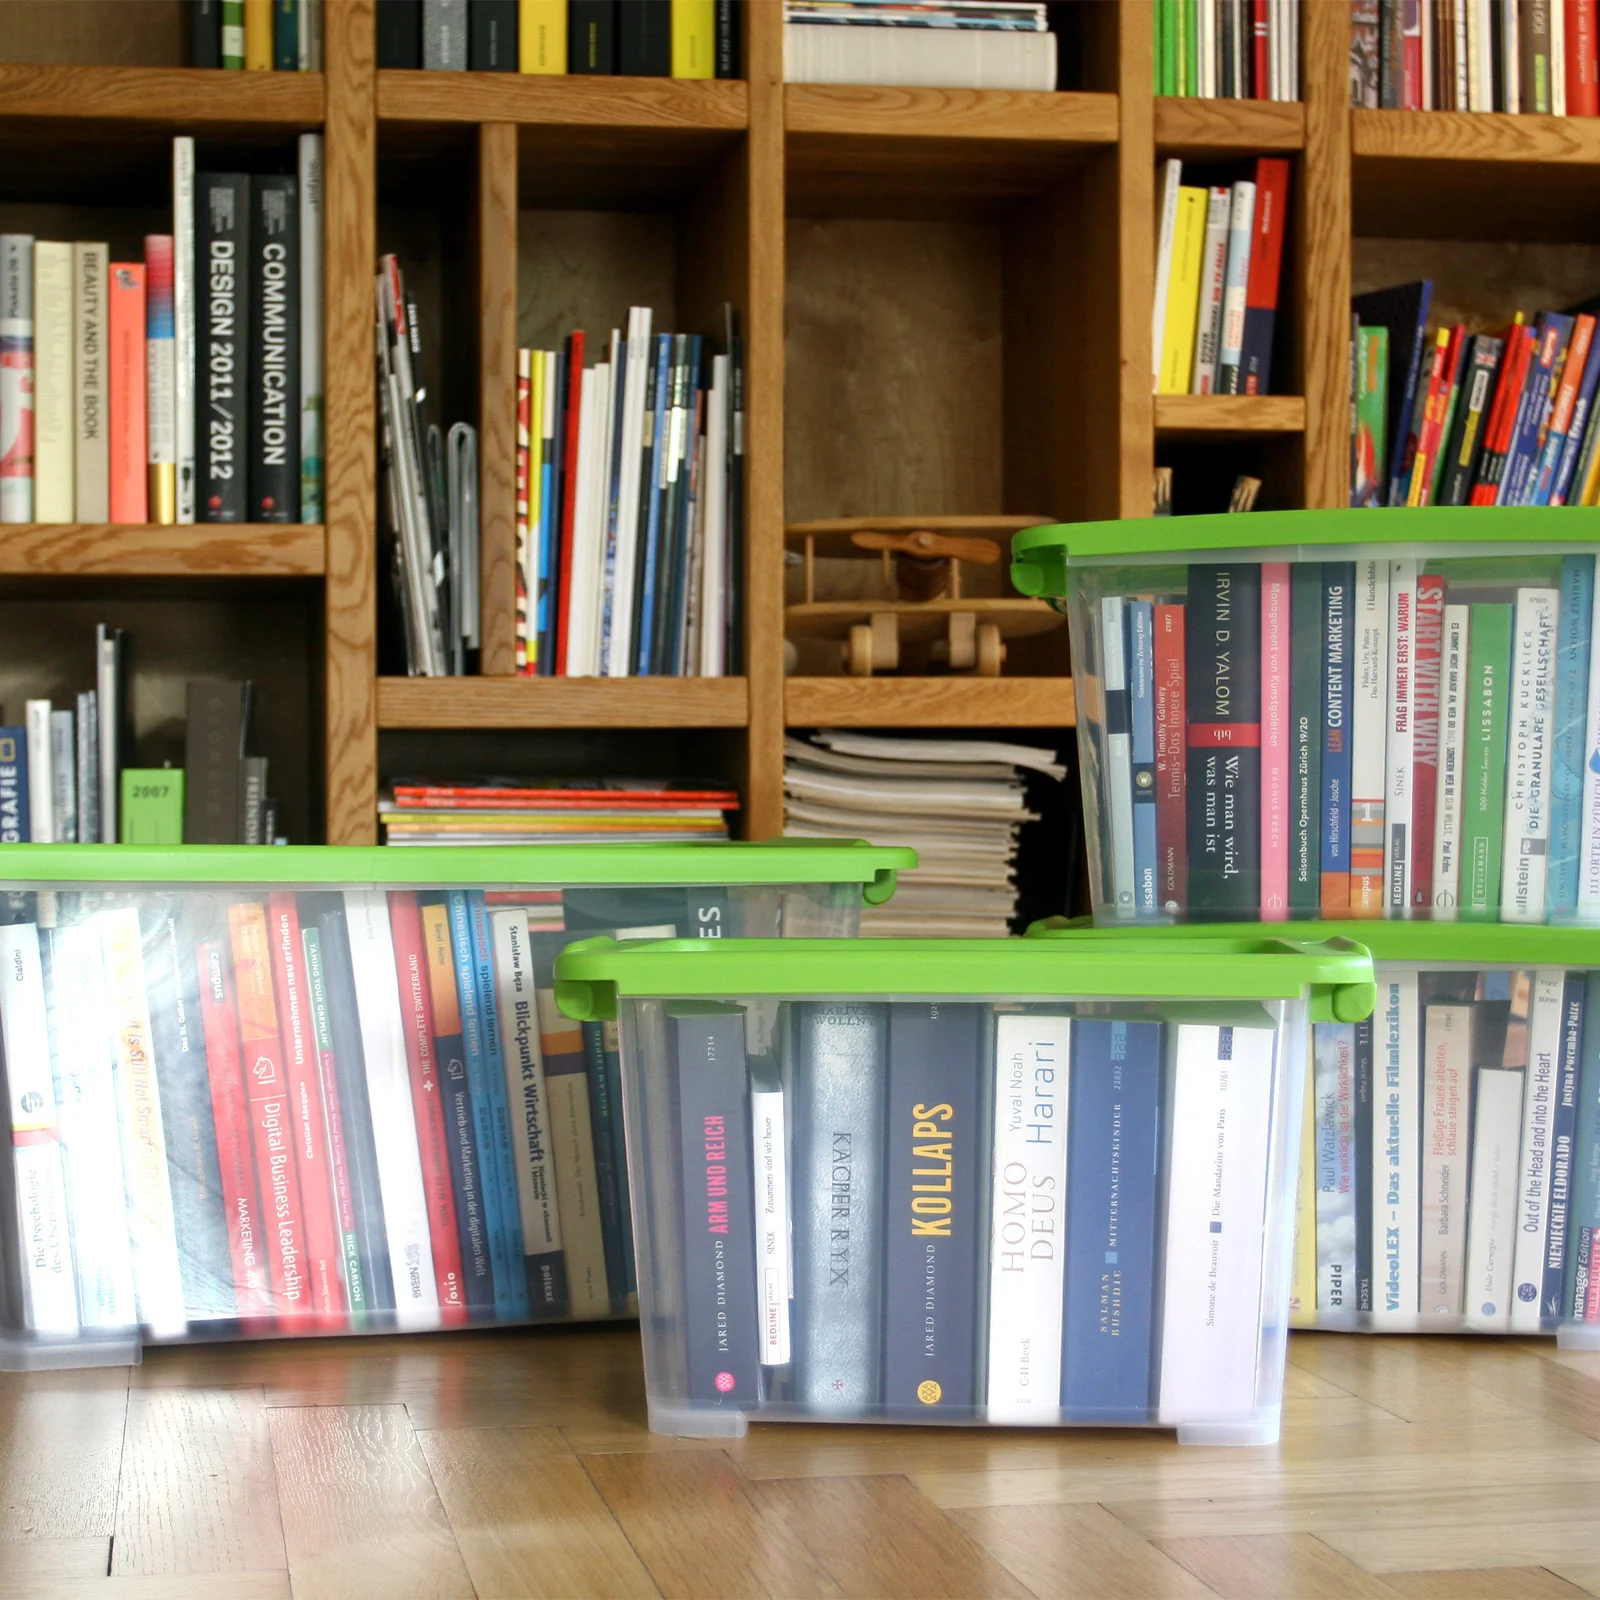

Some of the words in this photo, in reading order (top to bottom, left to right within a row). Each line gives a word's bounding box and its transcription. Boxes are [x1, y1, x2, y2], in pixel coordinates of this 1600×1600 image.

[84, 252, 100, 317] BEAUTY
[211, 240, 234, 336] DESIGN
[85, 320, 100, 355] AND
[263, 243, 286, 465] COMMUNICATION
[85, 359, 101, 389] THE
[85, 395, 101, 440] BOOK
[209, 342, 234, 480] 2011/2012
[1216, 572, 1230, 621] IRVIN
[1397, 593, 1409, 632] WARUM
[1268, 583, 1280, 651] Management
[1328, 586, 1342, 663] MARKETING
[1416, 587, 1442, 654] START
[1451, 622, 1459, 630] ES
[1216, 630, 1230, 647] D.
[1396, 635, 1408, 663] ERST:
[1450, 631, 1459, 651] KOMMT
[1449, 653, 1458, 669] NICHT
[1520, 630, 1532, 708] KUCKLICK
[1216, 652, 1230, 716] YALOM
[1328, 666, 1342, 727] CONTENT
[1396, 666, 1408, 703] IMMER
[1415, 658, 1440, 713] WITH
[1447, 694, 1456, 704] AN,
[1448, 671, 1457, 693] DARAUF
[1157, 686, 1167, 721] Gallwey
[1268, 675, 1280, 747] Kunstgalerien
[1396, 705, 1408, 733] FRAG
[1448, 706, 1456, 719] WER
[1481, 664, 1493, 741] LISSABON
[1157, 723, 1167, 758] Timothy
[1298, 717, 1309, 743] 19/20
[1328, 729, 1342, 753] LEAN
[1414, 718, 1439, 768] WHY
[1447, 720, 1456, 729] DU
[1157, 760, 1166, 771] W.
[1206, 756, 1216, 786] was
[1224, 755, 1238, 788] Wie
[1298, 745, 1308, 774] Zürich
[1446, 747, 1455, 772] SONDERN
[1515, 719, 1528, 810] CHRISTOPH
[132, 786, 171, 798] 2007
[1394, 767, 1404, 797] SINEK
[1445, 773, 1454, 786] WER
[1445, 788, 1453, 796] DU
[0, 766, 20, 842] GRAFIE
[1206, 792, 1216, 827] man
[1224, 794, 1234, 830] man
[1298, 777, 1309, 827] Opernhaus
[1206, 833, 1219, 853] ist
[1220, 837, 1238, 880] wird,
[1298, 830, 1307, 882] Saisonbuch
[1443, 841, 1451, 854] Paul
[1442, 855, 1451, 874] Arden.
[1393, 864, 1403, 905] REDLINE
[280, 914, 293, 962] erfinden
[454, 895, 470, 962] Chinesisch
[473, 895, 489, 962] Chinesisch
[698, 906, 722, 938] ES
[13, 949, 24, 982] Cialdini
[510, 926, 521, 968] Stanisław
[210, 952, 225, 999] campus
[286, 964, 295, 985] neu
[409, 953, 425, 1011] SWITZERLAND
[461, 965, 476, 1016] spielend
[480, 965, 495, 1016] spielend
[513, 971, 523, 992] Bęza
[289, 987, 304, 1065] Unternehmen
[415, 1014, 429, 1057] COMPLETE
[468, 1018, 479, 1056] lernen
[487, 1018, 497, 1056] lernen
[515, 1001, 537, 1081] Blickpunkt
[1386, 983, 1399, 1087] Filmlexikon
[420, 1059, 431, 1075] THE
[1009, 1052, 1023, 1089] Noah
[1337, 1040, 1348, 1101] Wirklichkeit?
[1434, 1042, 1449, 1084] arbeiten,
[1447, 1068, 1459, 1084] auf
[1533, 1052, 1550, 1083] Heart
[1026, 1041, 1055, 1144] Harari
[1338, 1103, 1348, 1118] die
[1433, 1085, 1446, 1117] Frauen
[1447, 1086, 1461, 1120] steigen
[1532, 1085, 1548, 1103] the
[262, 1103, 286, 1152] Digital
[523, 1083, 545, 1162] Wirtschaft
[763, 1117, 772, 1140] besser
[1008, 1094, 1023, 1132] Yuval
[1215, 1108, 1226, 1130] Paris
[1321, 1093, 1334, 1163] Watzlawick
[1338, 1120, 1348, 1133] ist
[1386, 1093, 1399, 1167] aktuelle
[1530, 1105, 1546, 1125] into
[705, 1115, 726, 1161] REICH
[763, 1141, 772, 1154] wir
[1338, 1136, 1349, 1173] wirklich
[1432, 1119, 1447, 1156] Fleißige
[1446, 1121, 1458, 1157] schlaue
[1530, 1127, 1545, 1147] and
[707, 1165, 727, 1196] UND
[763, 1156, 773, 1172] sind
[831, 1132, 851, 1220] KACPER
[911, 1103, 953, 1236] KOLLAPS
[1109, 1103, 1121, 1248] MITTERNACHTSKINDER
[1212, 1151, 1224, 1198] Mandarins
[1322, 1165, 1335, 1193] Paul
[1527, 1149, 1544, 1178] Head
[1553, 1135, 1570, 1200] ELDORADO
[270, 1155, 290, 1218] Business
[765, 1173, 774, 1214] Zusammen
[1339, 1174, 1349, 1194] Wie
[1386, 1172, 1399, 1205] Das
[1438, 1165, 1450, 1204] Schneider
[1526, 1180, 1542, 1197] the
[708, 1201, 729, 1234] ARM
[1001, 1161, 1027, 1273] HOMO
[1031, 1174, 1055, 1262] DEUS
[1211, 1201, 1221, 1217] Die
[1438, 1205, 1449, 1235] Barbara
[1524, 1215, 1539, 1233] Out
[1525, 1201, 1540, 1213] of
[345, 1233, 357, 1258] RICK
[766, 1231, 775, 1255] SINEK
[1548, 1202, 1565, 1270] NIEMIECKIE
[1578, 1227, 1590, 1264] Edition
[277, 1221, 302, 1301] Leadership
[715, 1240, 726, 1306] DIAMOND
[830, 1228, 850, 1287] RYX
[1207, 1239, 1218, 1278] Beauvoir
[1386, 1227, 1399, 1311] VideoLEX
[1439, 1251, 1447, 1295] GOLDMANN
[348, 1260, 362, 1302] CARSON
[444, 1272, 462, 1307] folio
[925, 1244, 935, 1310] DIAMOND
[1207, 1281, 1217, 1291] de
[1331, 1264, 1342, 1306] PIPER
[1099, 1272, 1108, 1333] SALMAN
[1112, 1269, 1121, 1336] RUSHDIE
[1206, 1293, 1216, 1327] Simone
[717, 1311, 727, 1352] JARED
[769, 1307, 777, 1346] REDLINE
[924, 1316, 934, 1357] JARED
